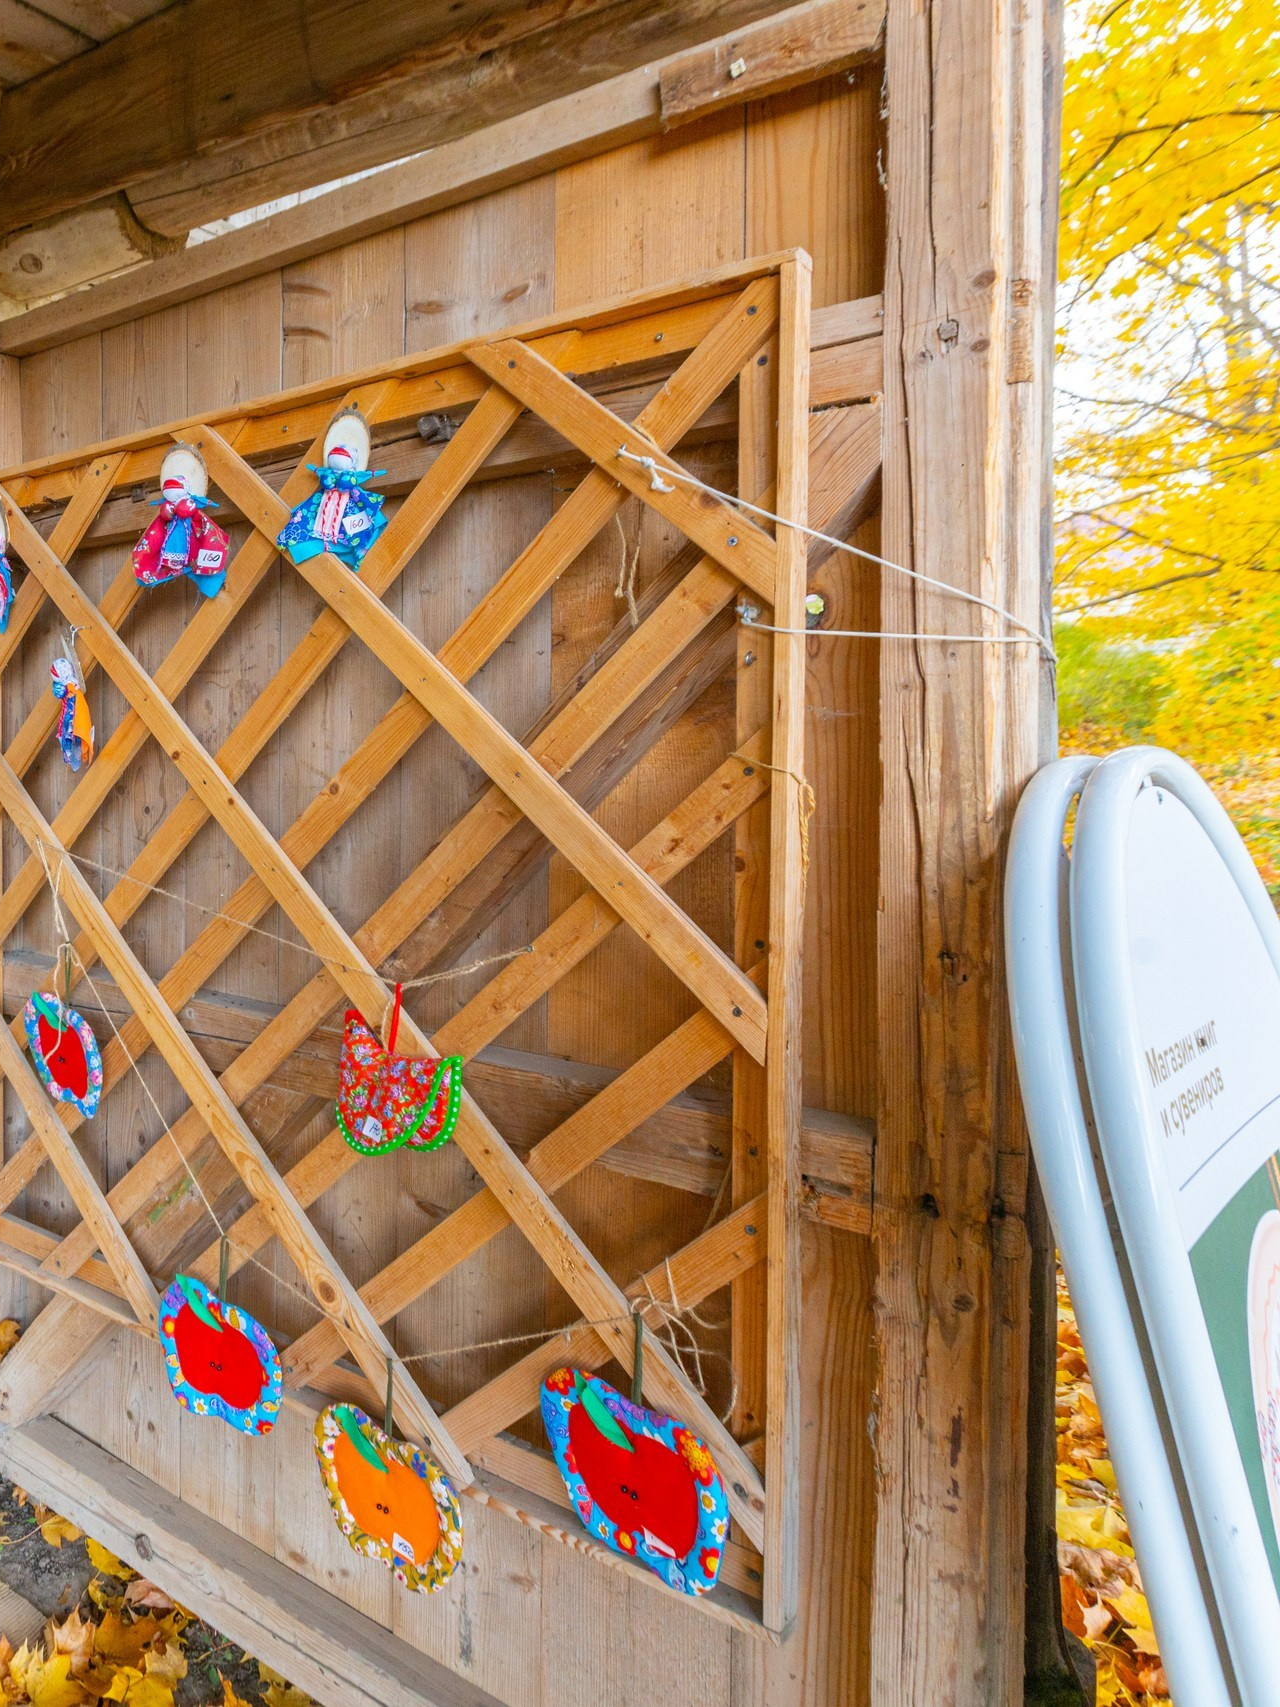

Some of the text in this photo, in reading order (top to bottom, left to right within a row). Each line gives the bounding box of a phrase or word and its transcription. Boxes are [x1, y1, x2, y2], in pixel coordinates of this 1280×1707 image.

[349, 518, 364, 530] 160
[202, 553, 221, 562] 160
[1144, 1020, 1218, 1089] Магазин книг
[1159, 1066, 1225, 1139] и сувениров
